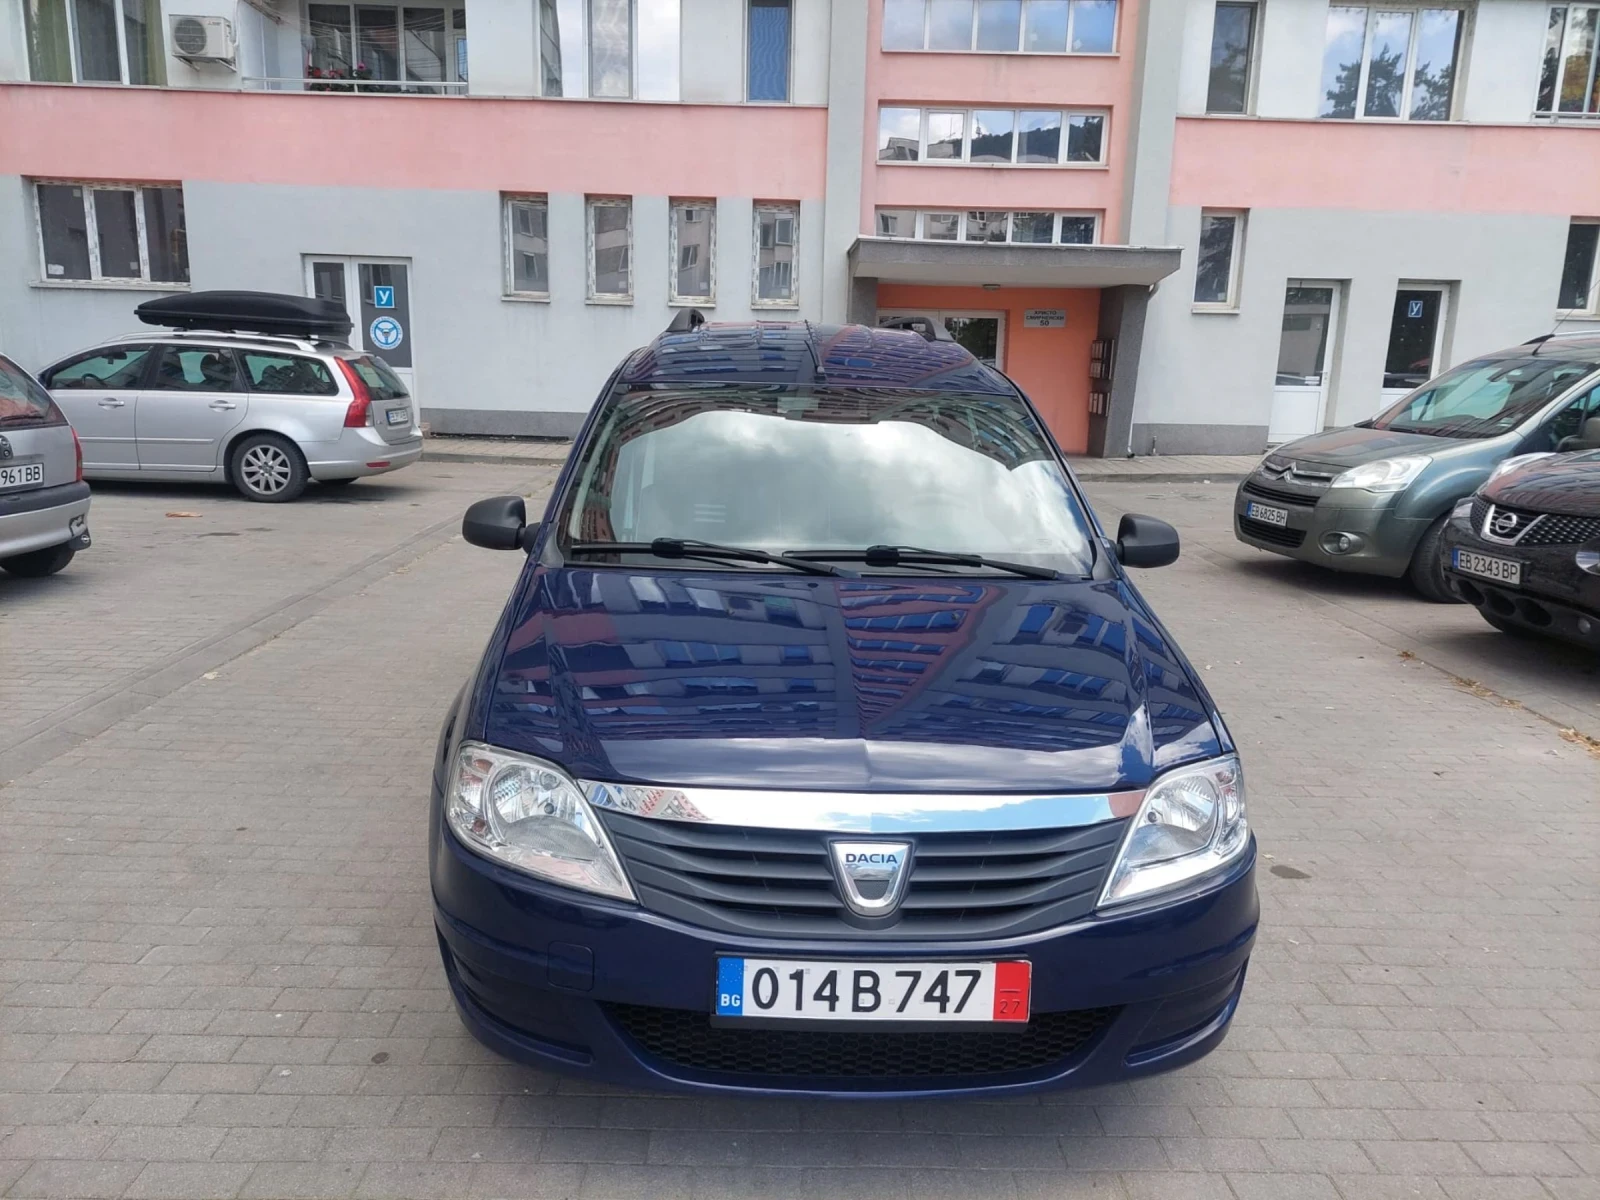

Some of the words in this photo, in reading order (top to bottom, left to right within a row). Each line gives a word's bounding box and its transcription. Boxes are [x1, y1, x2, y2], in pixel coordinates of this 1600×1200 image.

[845, 853, 898, 864] DACIA
[720, 993, 741, 1007] BG
[999, 999, 1021, 1014] 27
